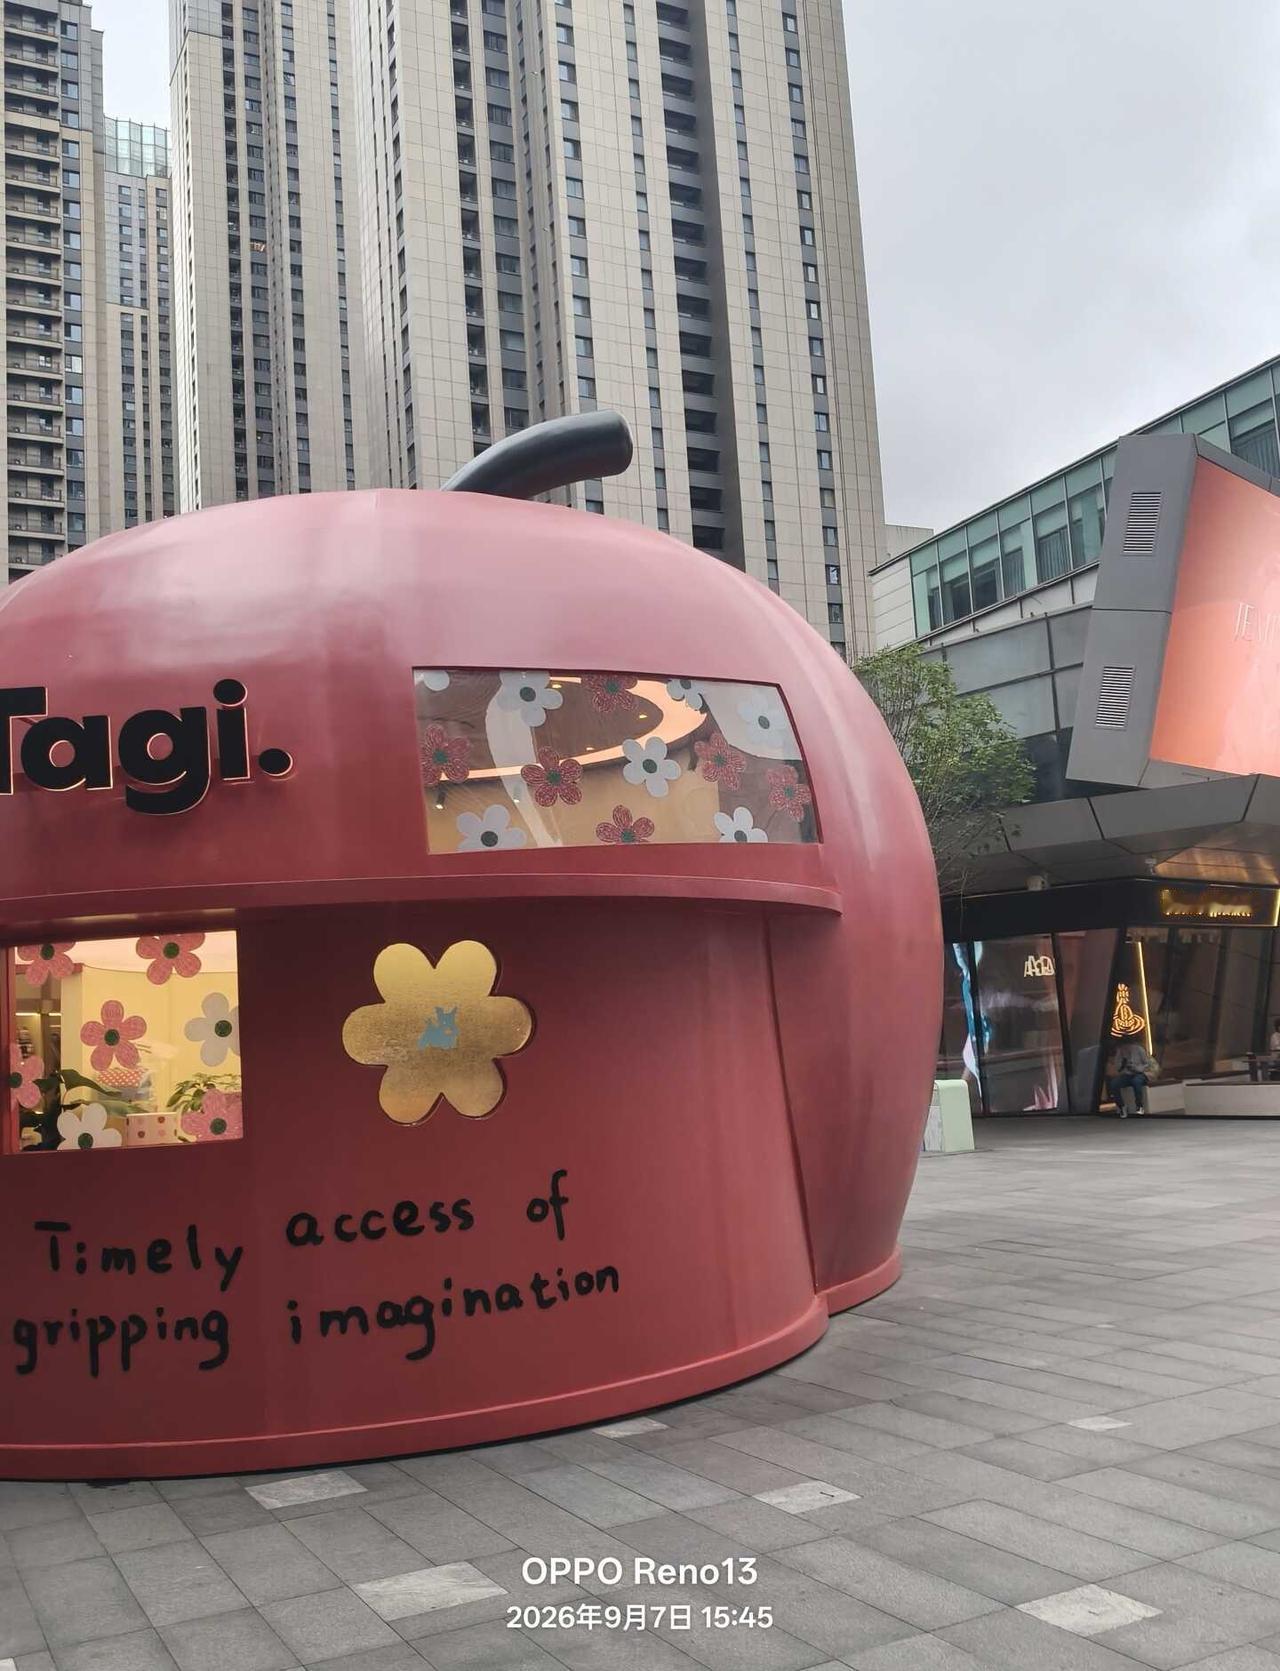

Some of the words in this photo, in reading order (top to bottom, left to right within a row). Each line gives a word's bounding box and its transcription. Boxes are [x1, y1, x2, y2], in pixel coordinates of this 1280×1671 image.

[33, 1219, 244, 1293] Timely
[285, 1198, 475, 1248] access
[526, 1168, 569, 1241] of
[12, 1306, 230, 1378] gripping
[286, 1265, 620, 1361] imagination
